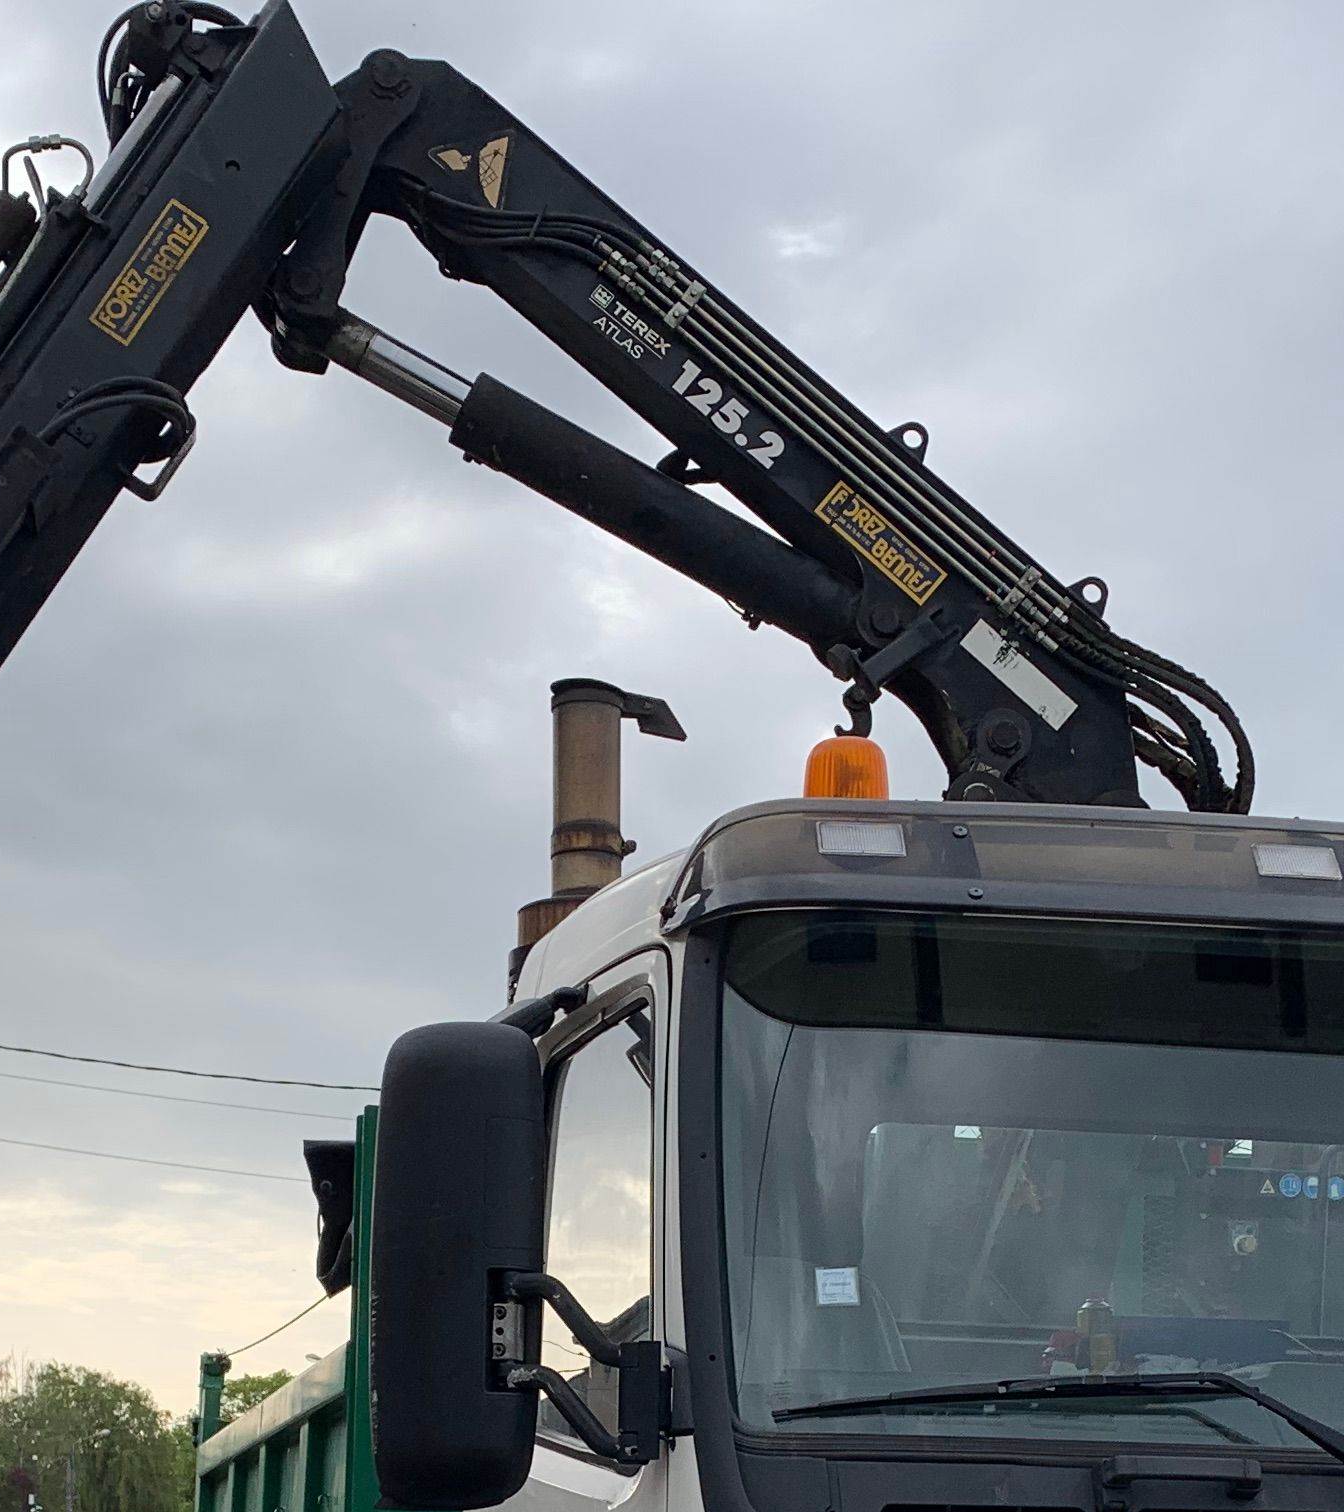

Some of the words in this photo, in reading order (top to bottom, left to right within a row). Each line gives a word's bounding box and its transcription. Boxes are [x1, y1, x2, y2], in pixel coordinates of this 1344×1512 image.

[144, 213, 199, 283] BENNES
[98, 267, 149, 329] FOREZ
[593, 315, 644, 360] ATLAS
[613, 301, 672, 356] TEREX
[671, 358, 786, 470] 125.2
[870, 537, 933, 594] BENNES
